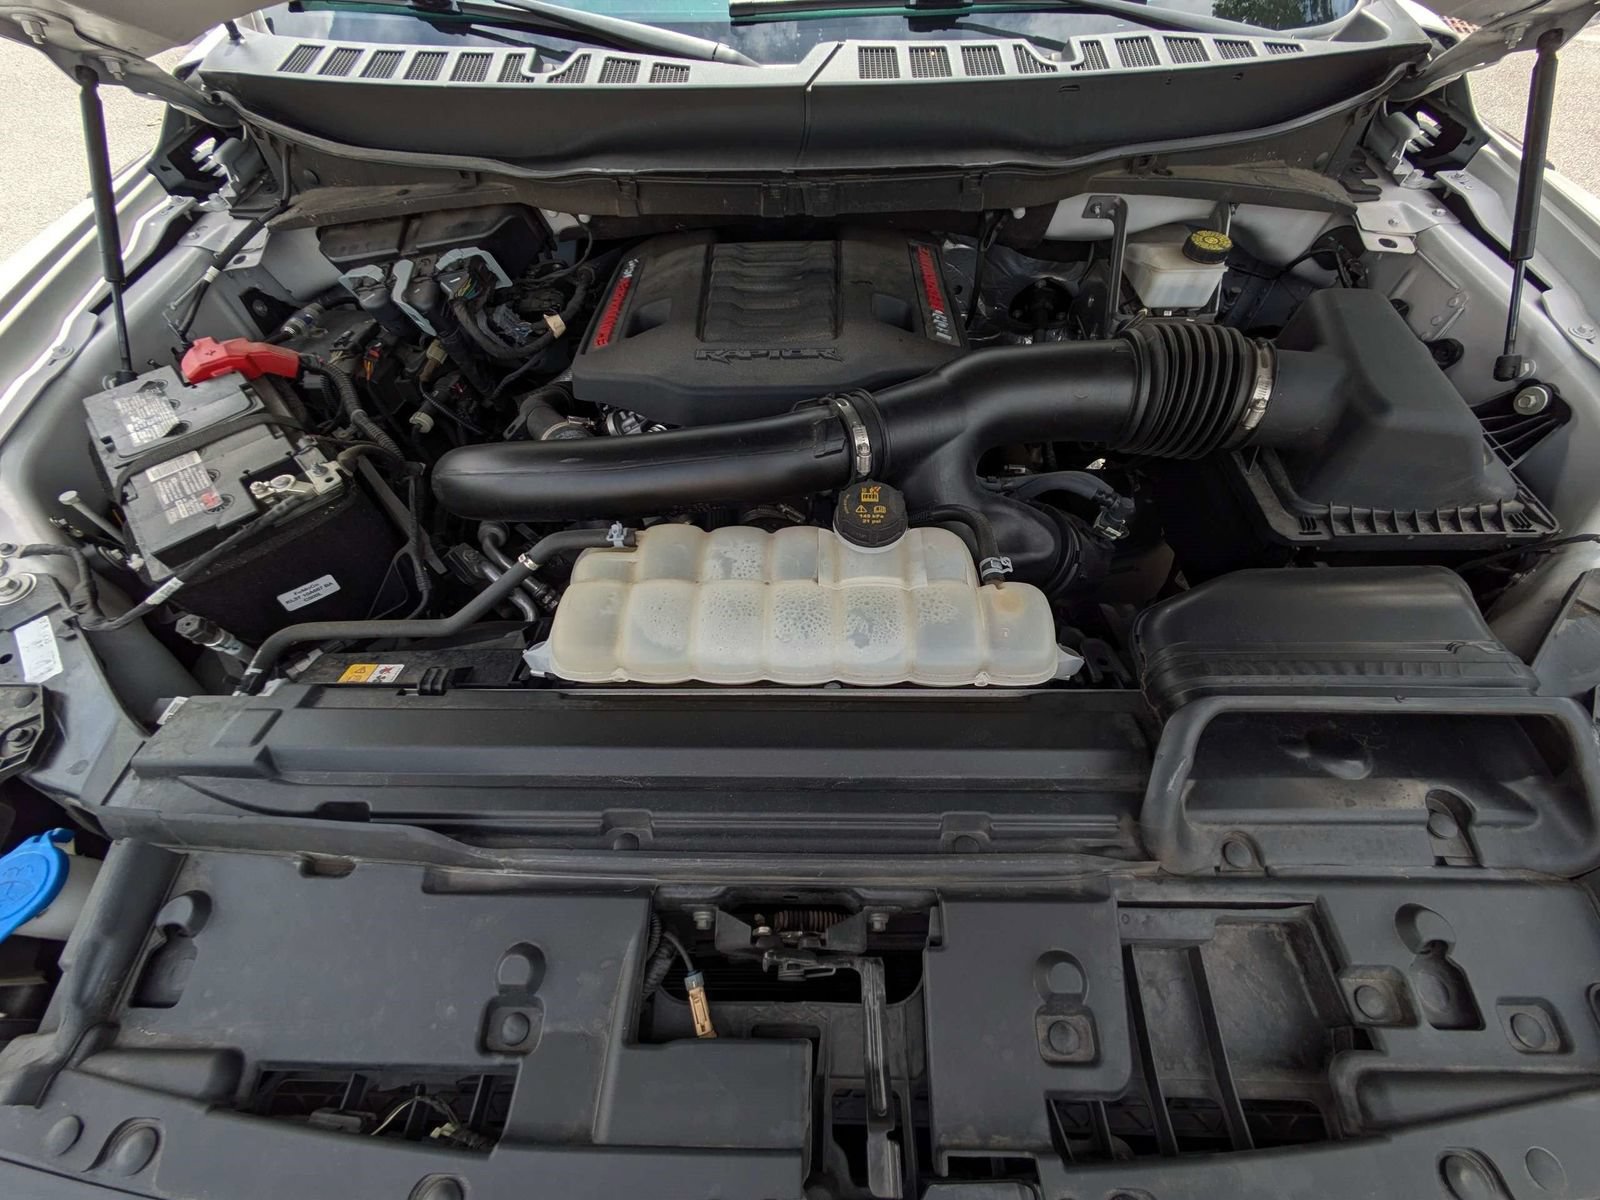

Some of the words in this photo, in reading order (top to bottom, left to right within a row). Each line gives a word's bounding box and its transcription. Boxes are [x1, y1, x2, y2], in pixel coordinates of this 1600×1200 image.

[593, 277, 632, 348] PERFORMANCE
[917, 245, 945, 313] PERFORMANCE
[694, 348, 844, 364] RAPTOR
